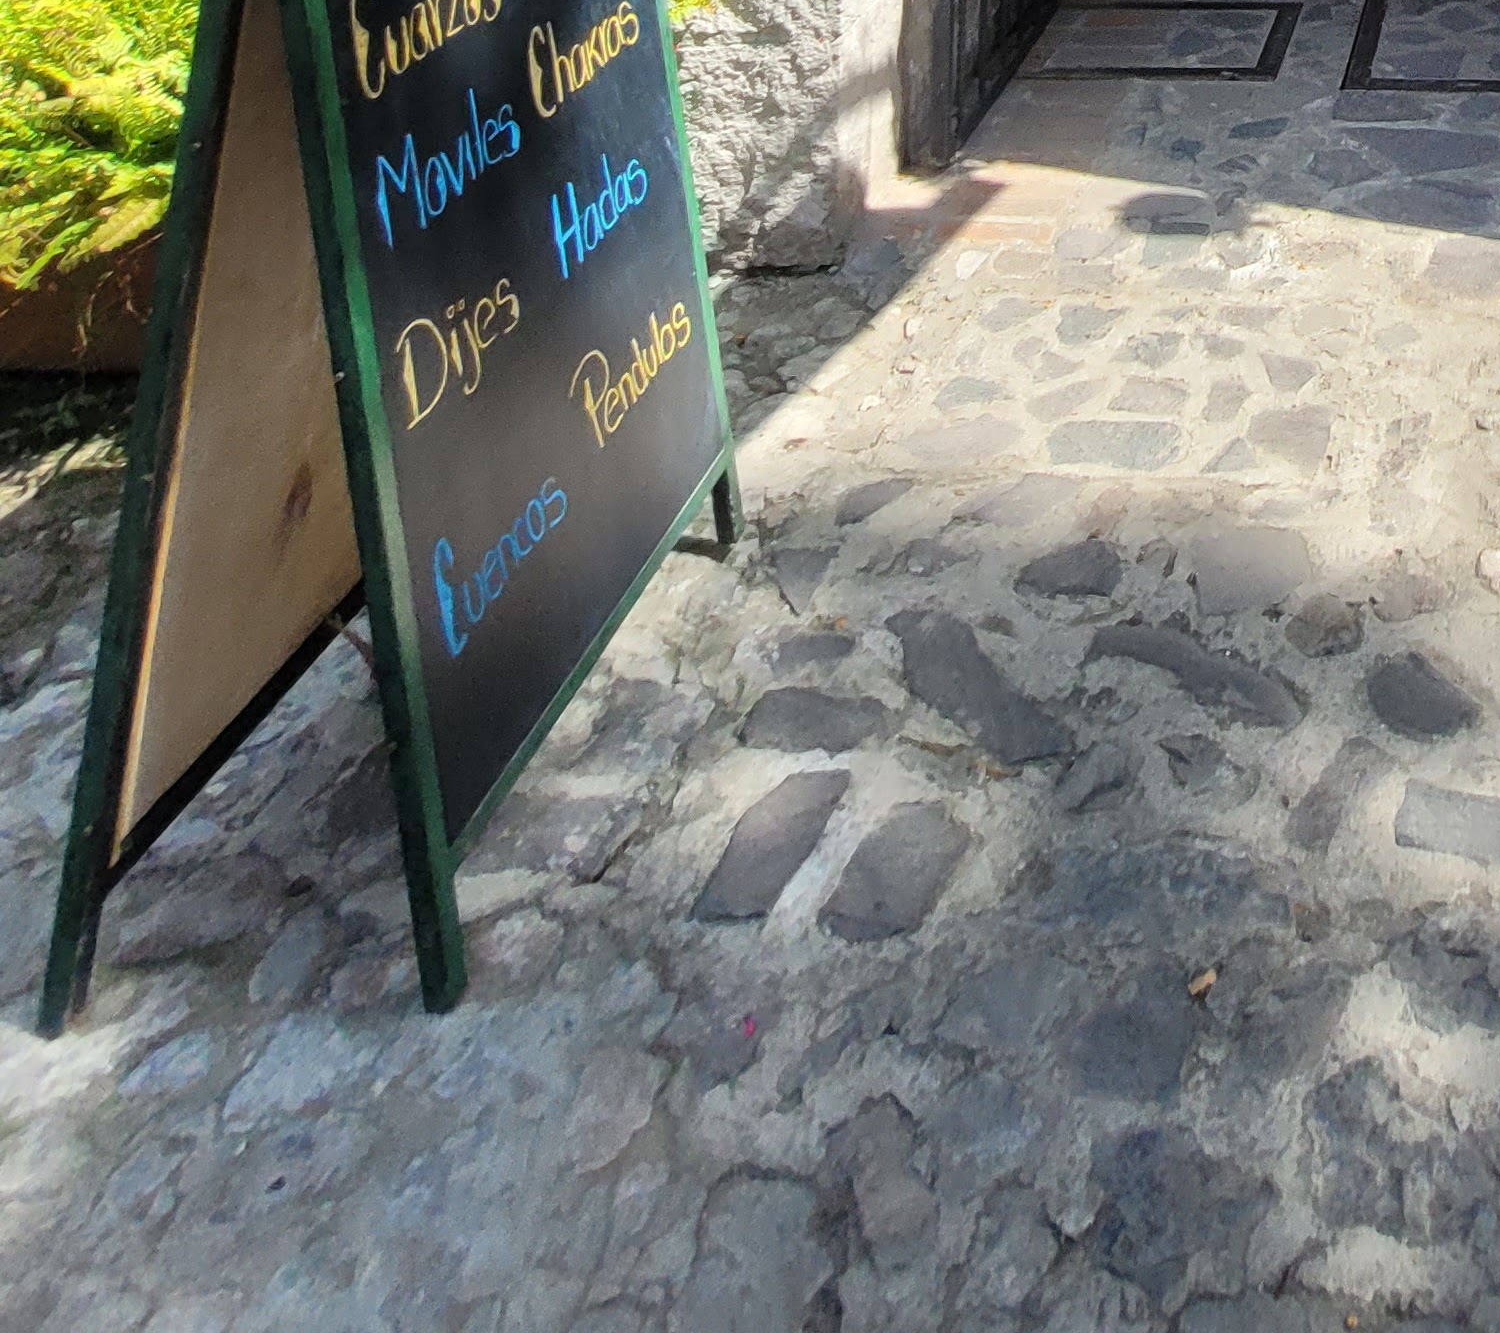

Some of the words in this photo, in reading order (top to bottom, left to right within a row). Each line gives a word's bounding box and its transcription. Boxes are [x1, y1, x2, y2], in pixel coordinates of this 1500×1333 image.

[527, 0, 641, 119] Chakras
[375, 88, 522, 247] Moviles
[550, 153, 648, 279] Hadas
[394, 277, 521, 430] Dijes
[569, 301, 693, 448] Pendulos
[433, 476, 570, 659] Cuencos
